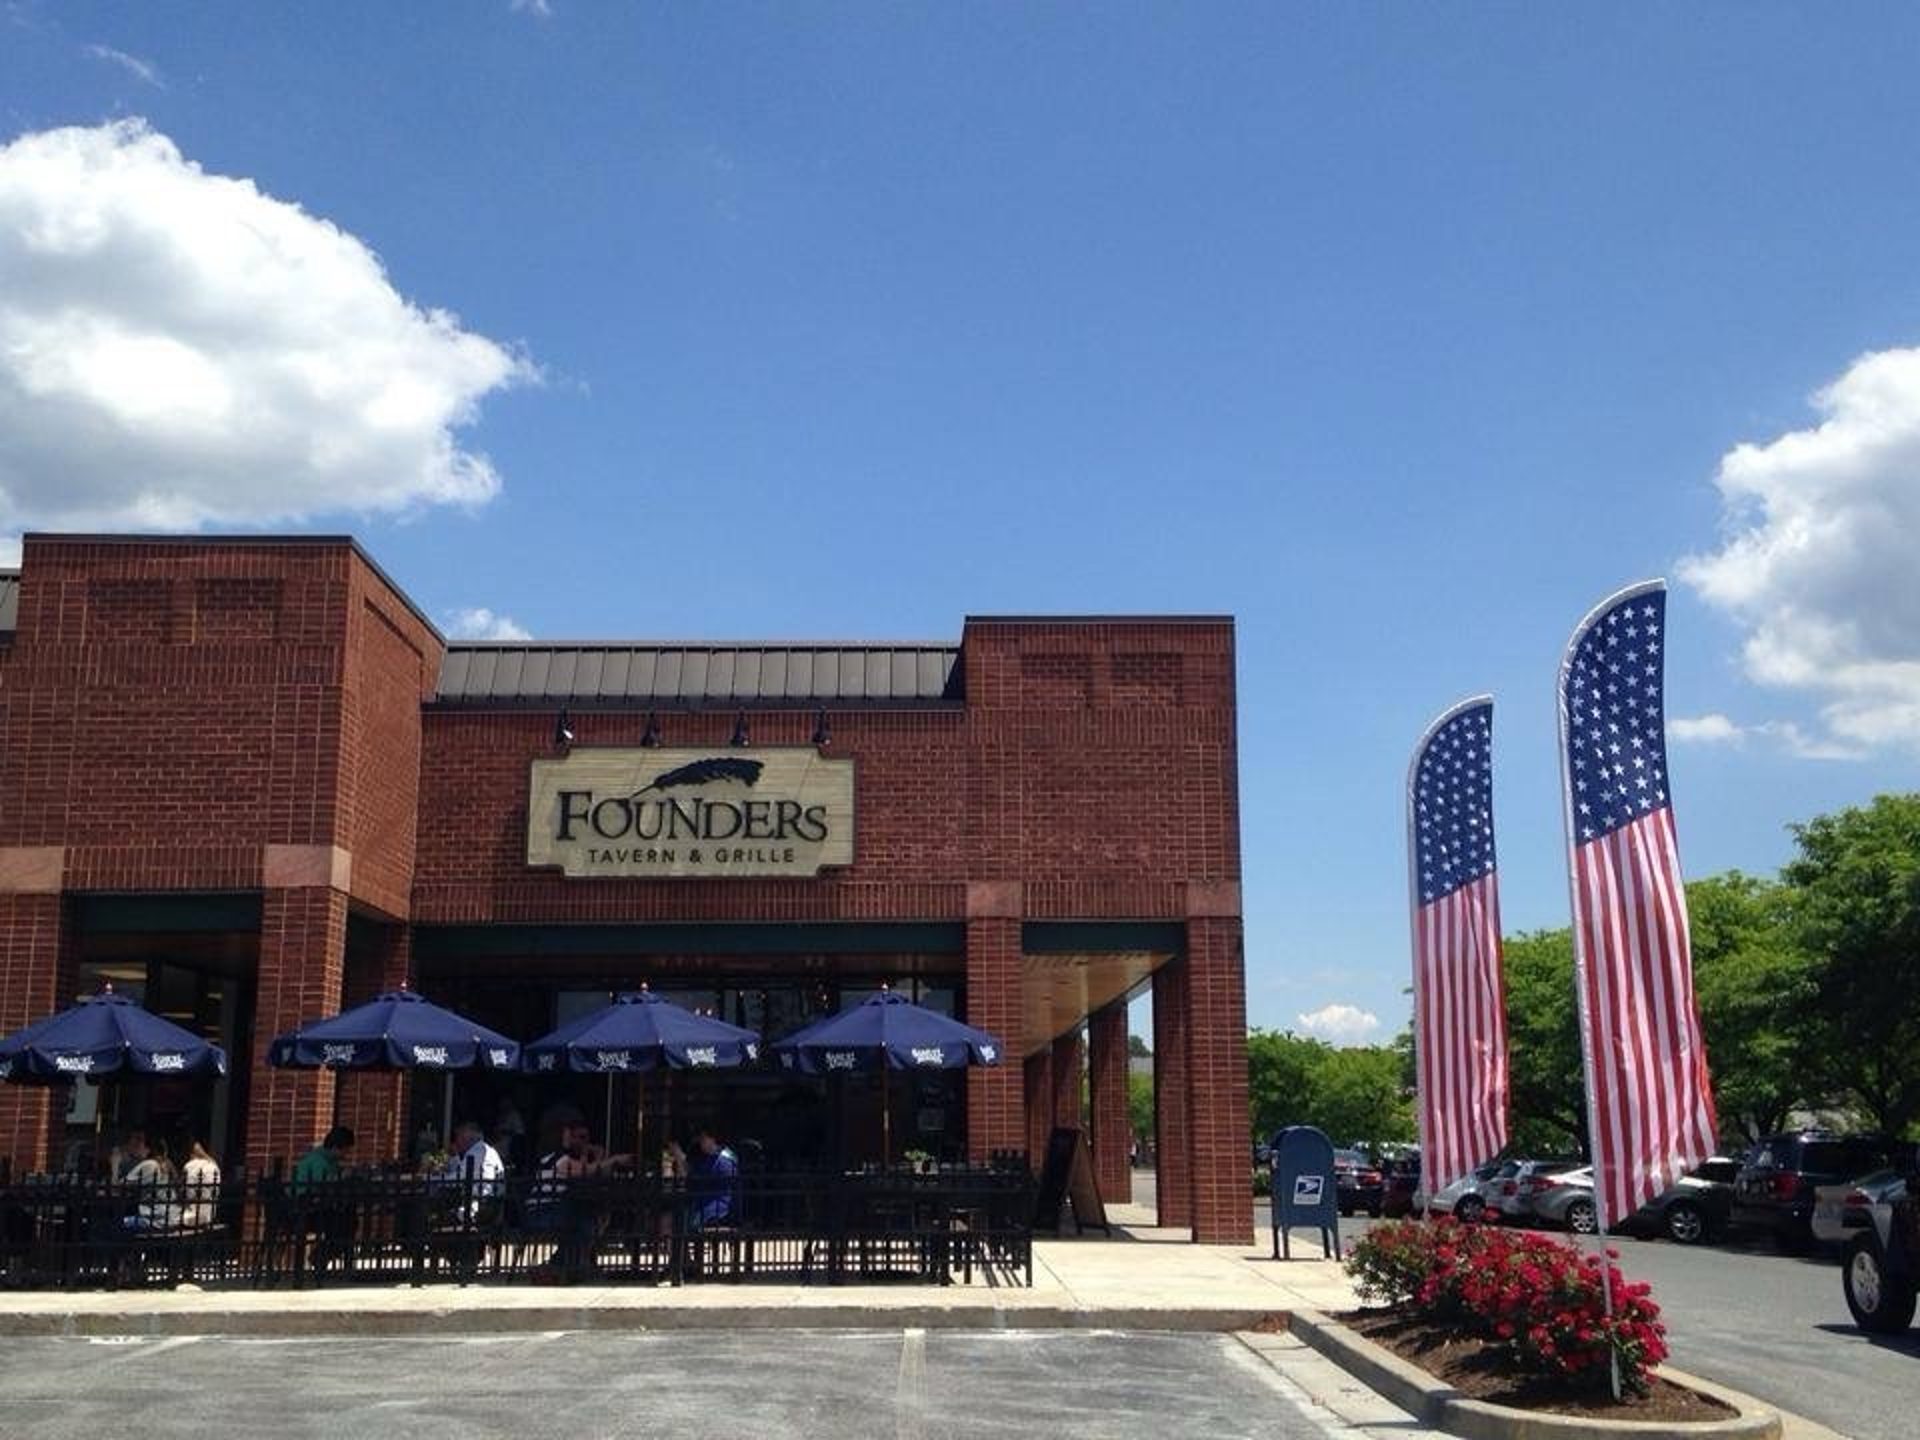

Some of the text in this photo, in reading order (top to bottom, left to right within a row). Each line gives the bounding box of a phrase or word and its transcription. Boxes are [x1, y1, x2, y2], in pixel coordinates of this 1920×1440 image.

[556, 791, 828, 842] FOUNDERS
[588, 848, 795, 864] TAVERN & GRILLE
